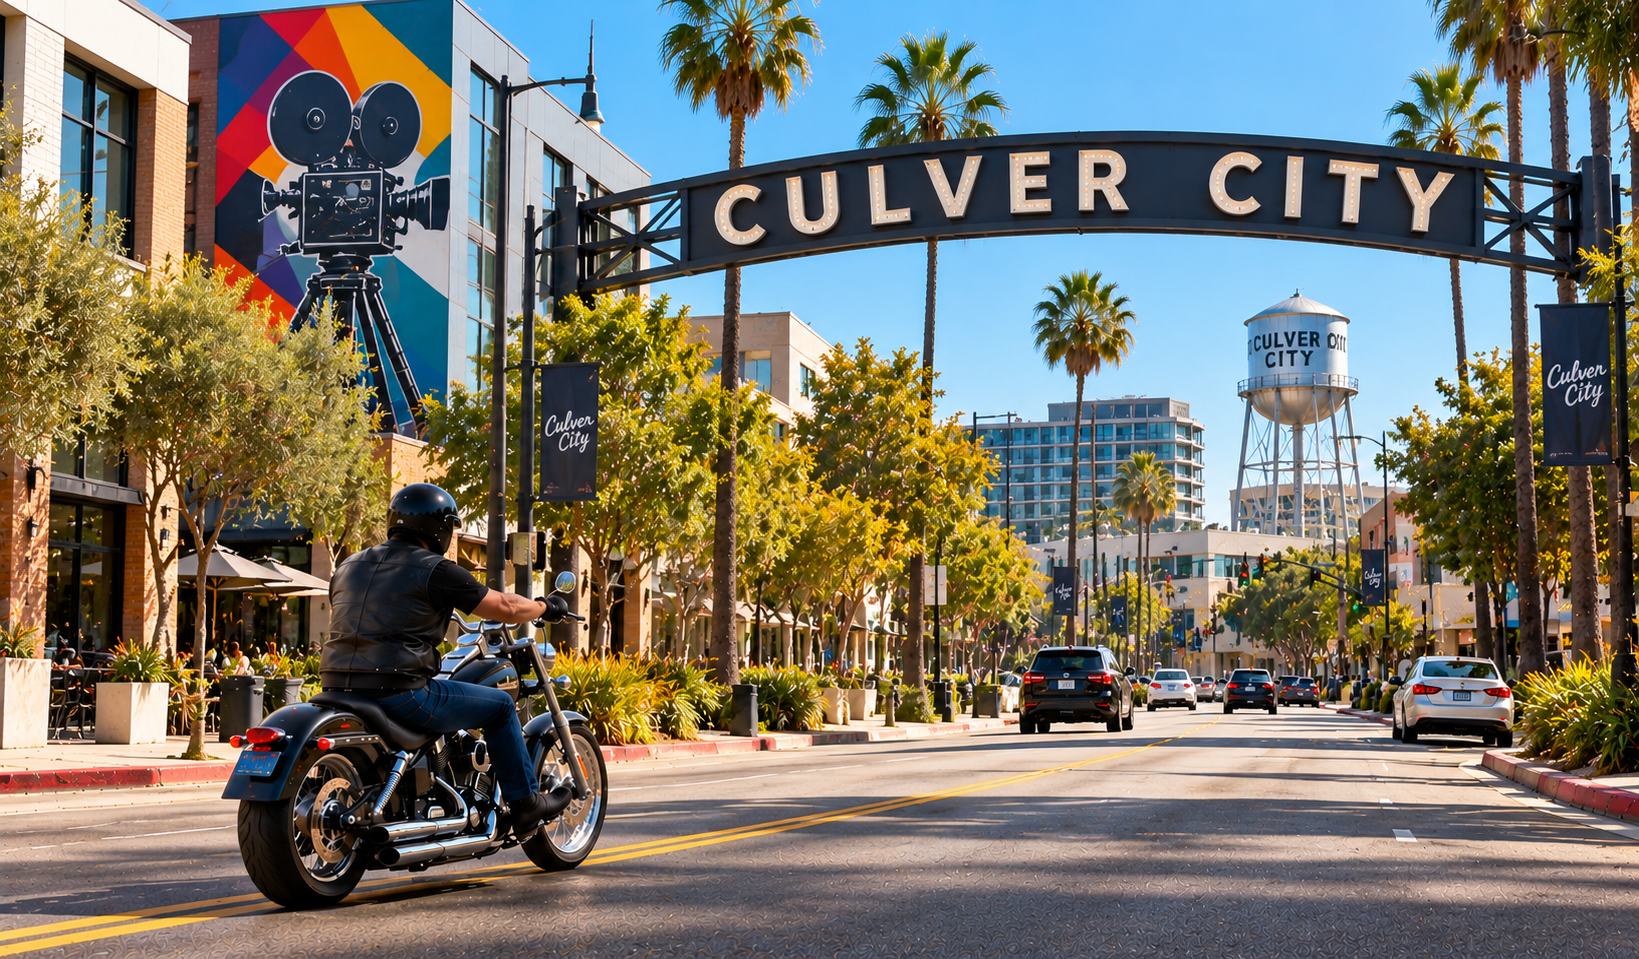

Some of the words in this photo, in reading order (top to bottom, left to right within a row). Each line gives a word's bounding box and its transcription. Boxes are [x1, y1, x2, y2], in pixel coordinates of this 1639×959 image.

[713, 149, 1130, 246] CULVER
[1208, 151, 1455, 233] CITY
[1253, 331, 1321, 352] CULVER
[1264, 350, 1314, 368] CITY
[1546, 360, 1608, 389] Culver
[1564, 380, 1604, 408] City
[544, 410, 595, 437] Culver
[558, 430, 590, 453] City
